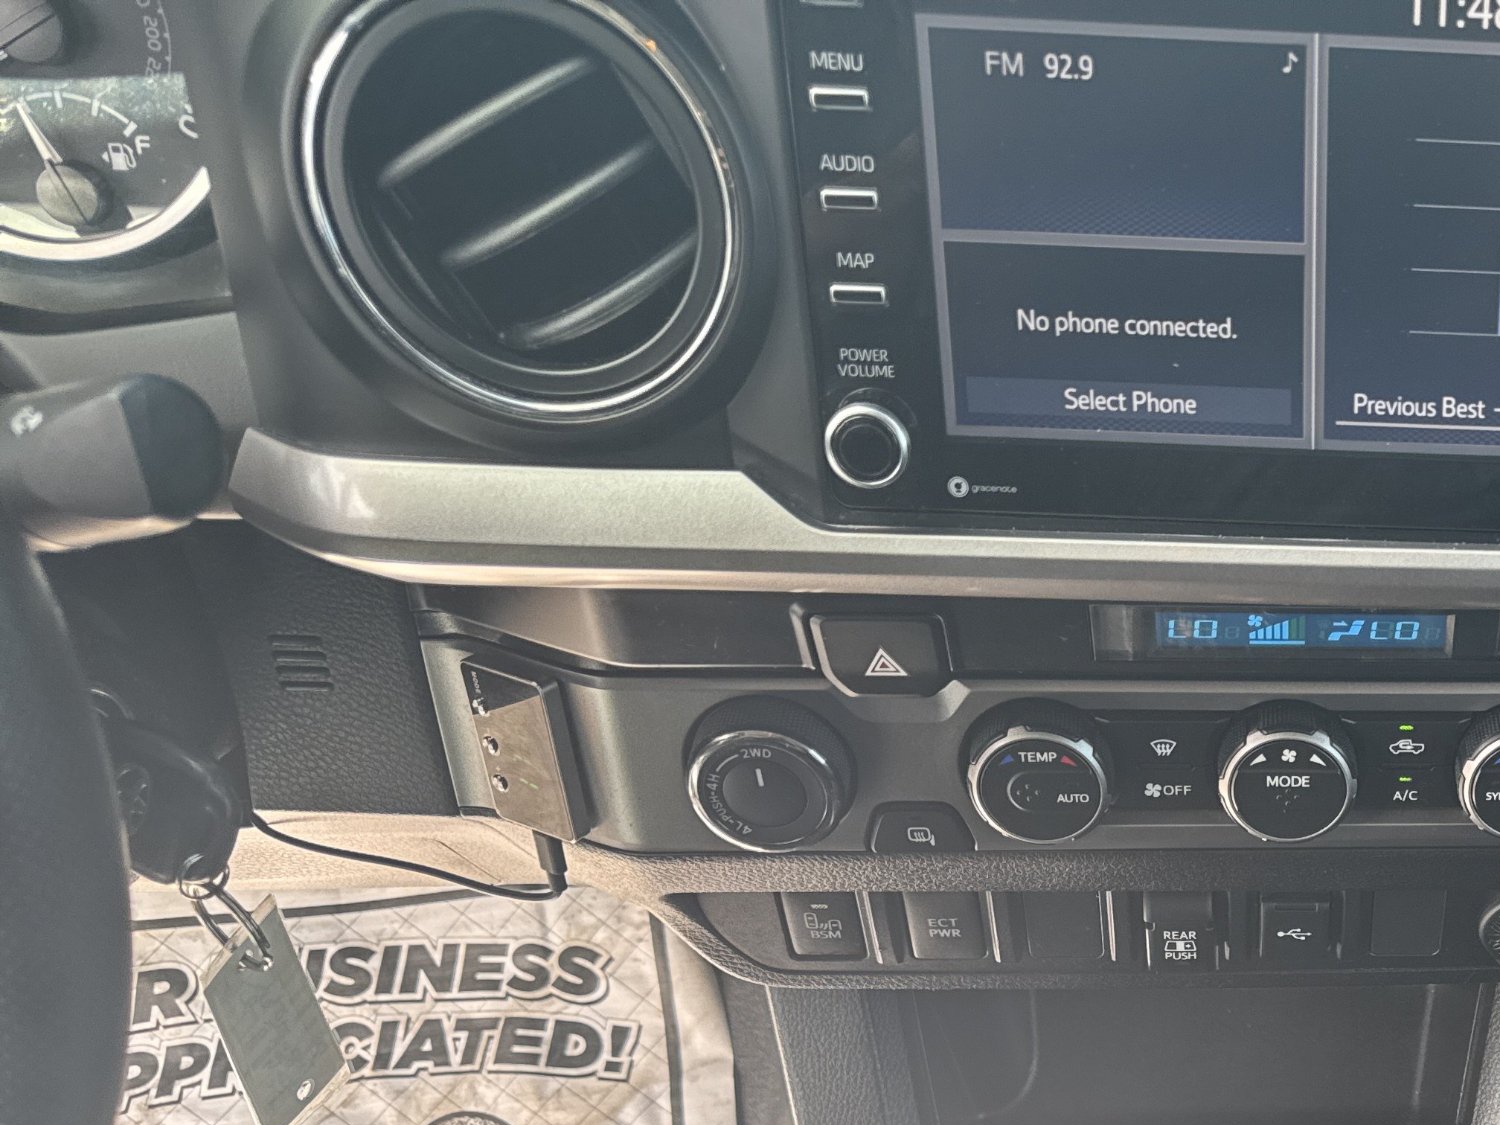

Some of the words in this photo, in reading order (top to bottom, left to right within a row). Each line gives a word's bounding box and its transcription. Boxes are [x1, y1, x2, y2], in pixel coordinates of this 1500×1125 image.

[809, 50, 864, 72] MENU
[985, 51, 1024, 77] FM
[1043, 53, 1093, 80] 92.9
[819, 154, 875, 173] AUDIO
[836, 252, 875, 269] MAP
[1016, 308, 1050, 332] No
[1055, 311, 1120, 337] phone
[1124, 317, 1239, 340] connected.
[839, 348, 889, 363] POWER
[837, 364, 896, 379] VOLUME
[1063, 387, 1127, 412] Select
[1132, 390, 1198, 416] Phone
[1353, 393, 1437, 418] Previous
[1441, 396, 1486, 420] Best
[741, 748, 772, 759] 2WD
[1017, 751, 1057, 763] TEMP
[1266, 775, 1311, 788] MODE
[1162, 785, 1192, 796] OFF
[1393, 790, 1418, 801] A/C
[1056, 793, 1090, 804] AUTO
[927, 918, 958, 928] ECT
[810, 930, 842, 939] BSM
[929, 928, 962, 938] PWR
[1163, 930, 1197, 940] REAR
[1164, 951, 1197, 961] PUSH
[302, 940, 609, 1002] SINESS
